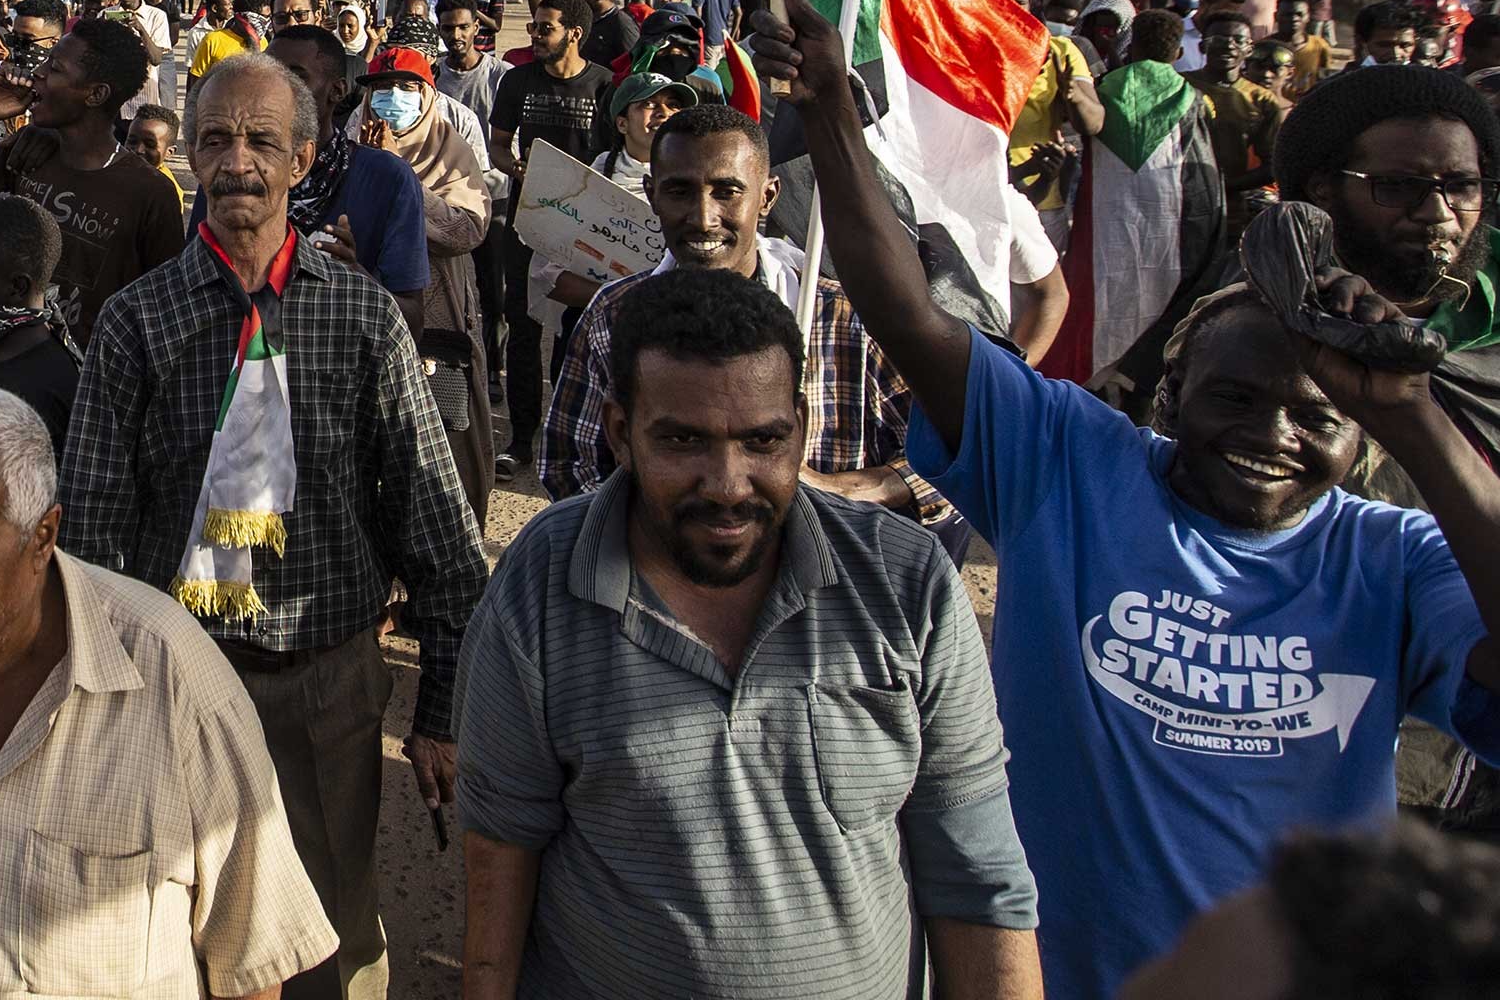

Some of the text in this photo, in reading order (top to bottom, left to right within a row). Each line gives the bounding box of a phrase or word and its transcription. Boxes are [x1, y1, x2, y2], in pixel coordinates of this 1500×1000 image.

[20, 176, 46, 195] TIME
[72, 213, 115, 240] NOW
[1108, 591, 1313, 671] GETTING
[1154, 589, 1232, 628] JUST
[1101, 639, 1314, 709] STARTED
[1133, 693, 1312, 731] CAMP MINI-YO-WE
[1165, 729, 1272, 752] SUMMER 2019
